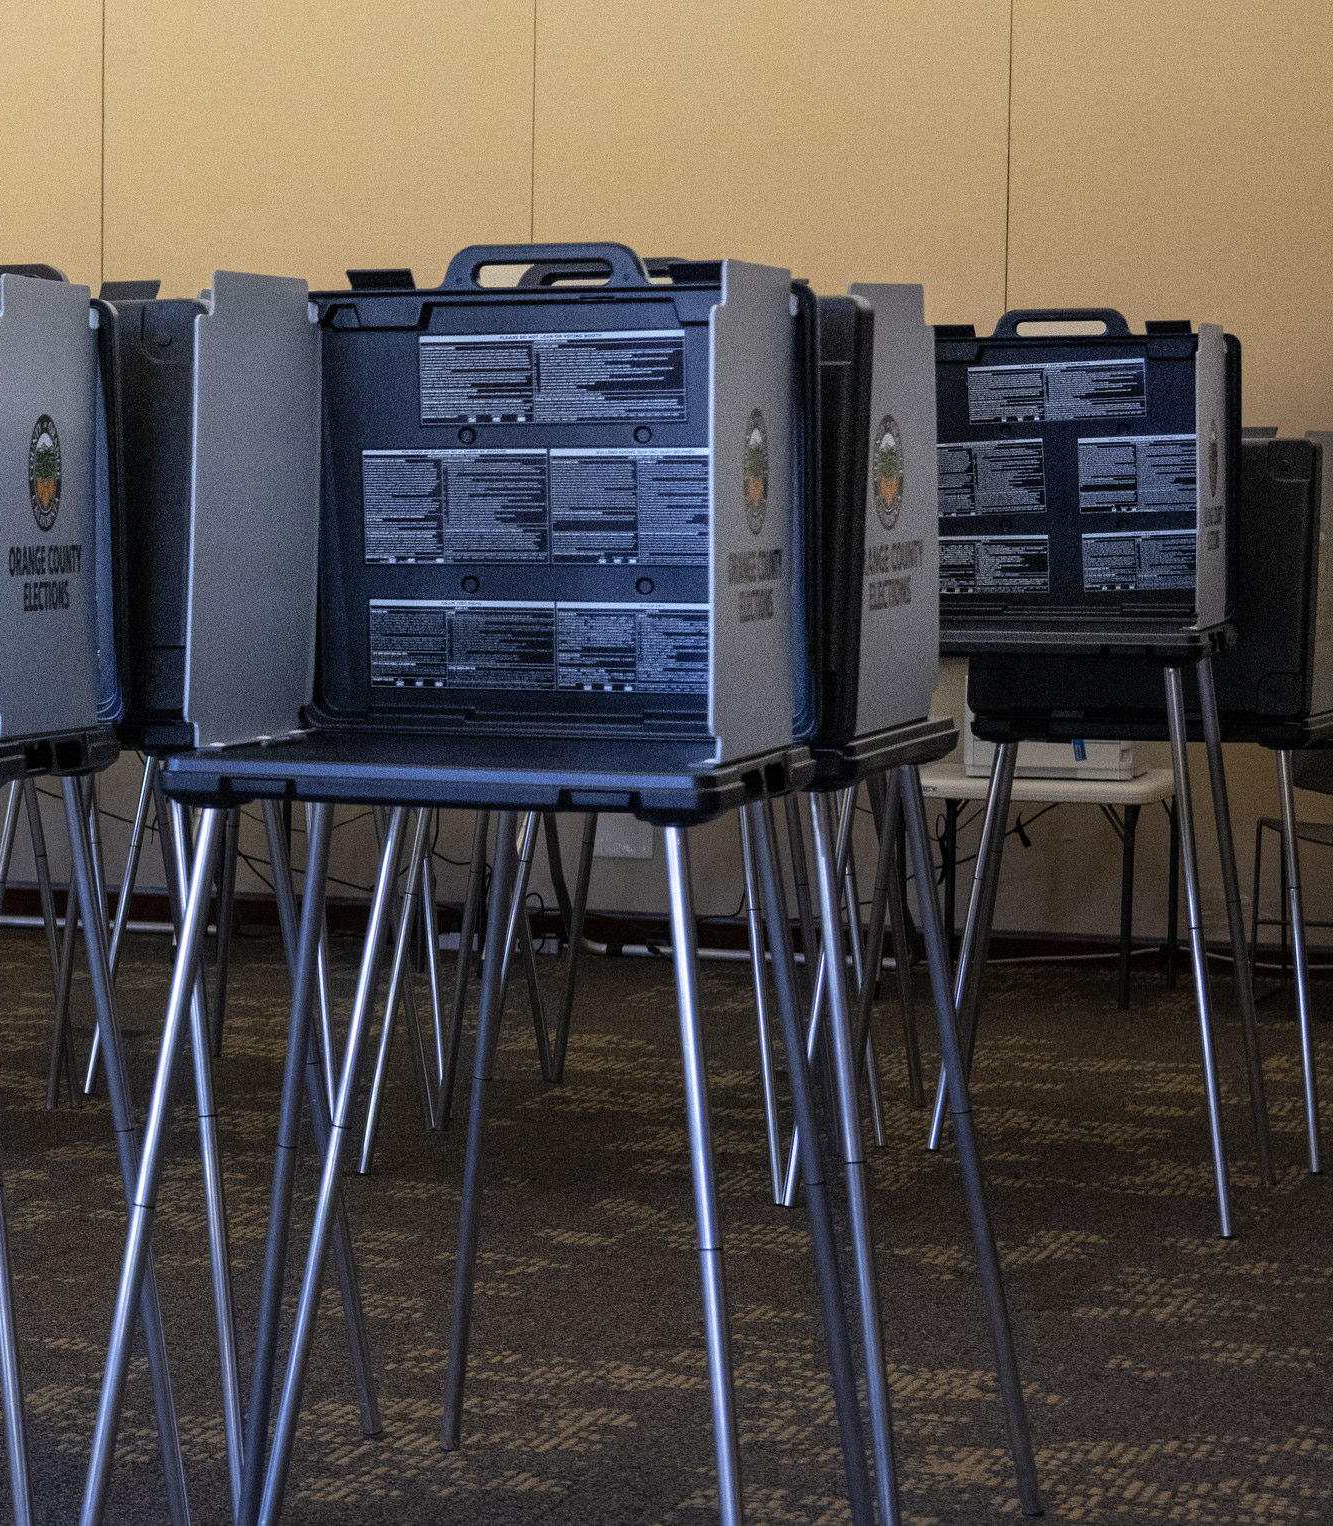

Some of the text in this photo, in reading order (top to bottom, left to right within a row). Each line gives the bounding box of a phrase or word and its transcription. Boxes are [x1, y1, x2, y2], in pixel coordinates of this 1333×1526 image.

[8, 544, 82, 577] ORANGE COUNTY
[23, 580, 70, 612] ELECTIONS
